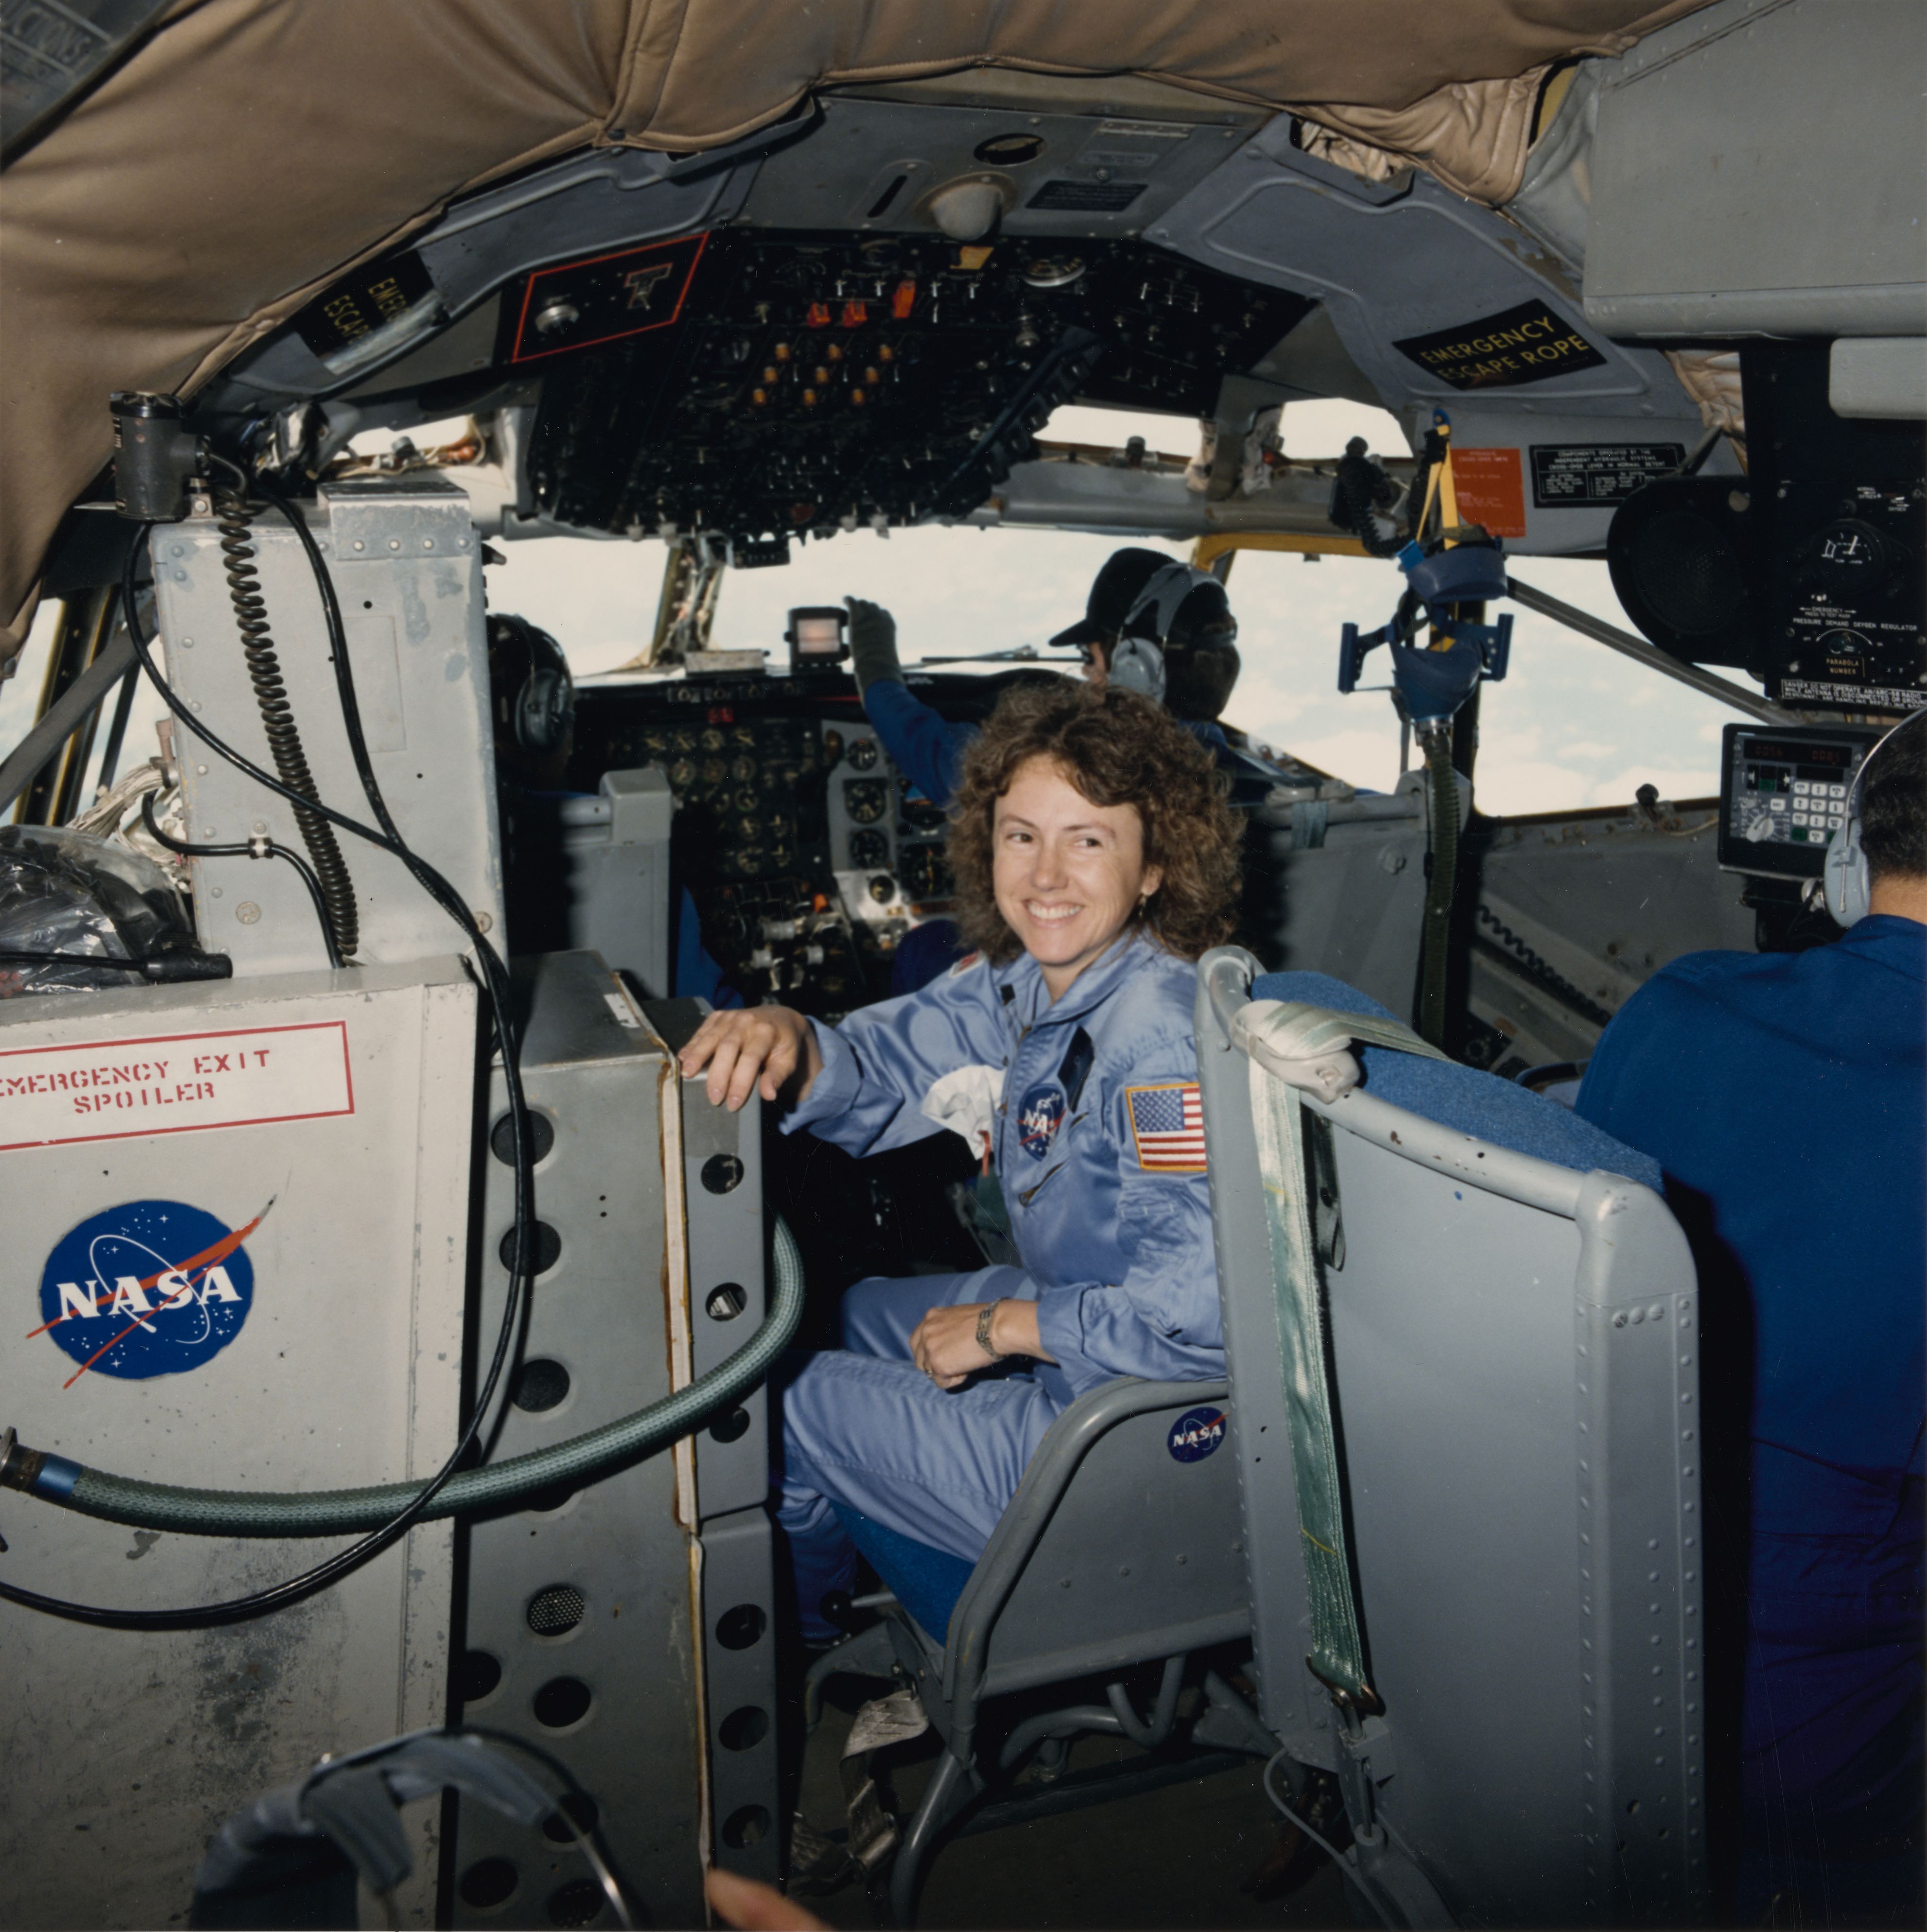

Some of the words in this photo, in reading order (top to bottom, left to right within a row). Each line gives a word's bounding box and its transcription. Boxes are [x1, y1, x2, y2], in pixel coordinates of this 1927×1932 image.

[1420, 316, 1555, 364] EMERGENCY
[1436, 356, 1522, 381] ESCAPE
[1519, 334, 1590, 366] ROPE
[1880, 622, 1918, 631] REGULATOR
[1826, 657, 1859, 667] PARABOLA
[1829, 666, 1857, 675] NUMBER
[1833, 684, 1861, 694] OPERATE
[1902, 691, 1922, 699] RADIO
[1841, 691, 1889, 701] DISCONNECTED
[0, 1060, 169, 1097] MERGENCY
[193, 1049, 271, 1075] EXIT
[73, 1081, 216, 1114] SPOILER
[56, 1265, 243, 1322] NASA
[1172, 1424, 1222, 1448] NASA
